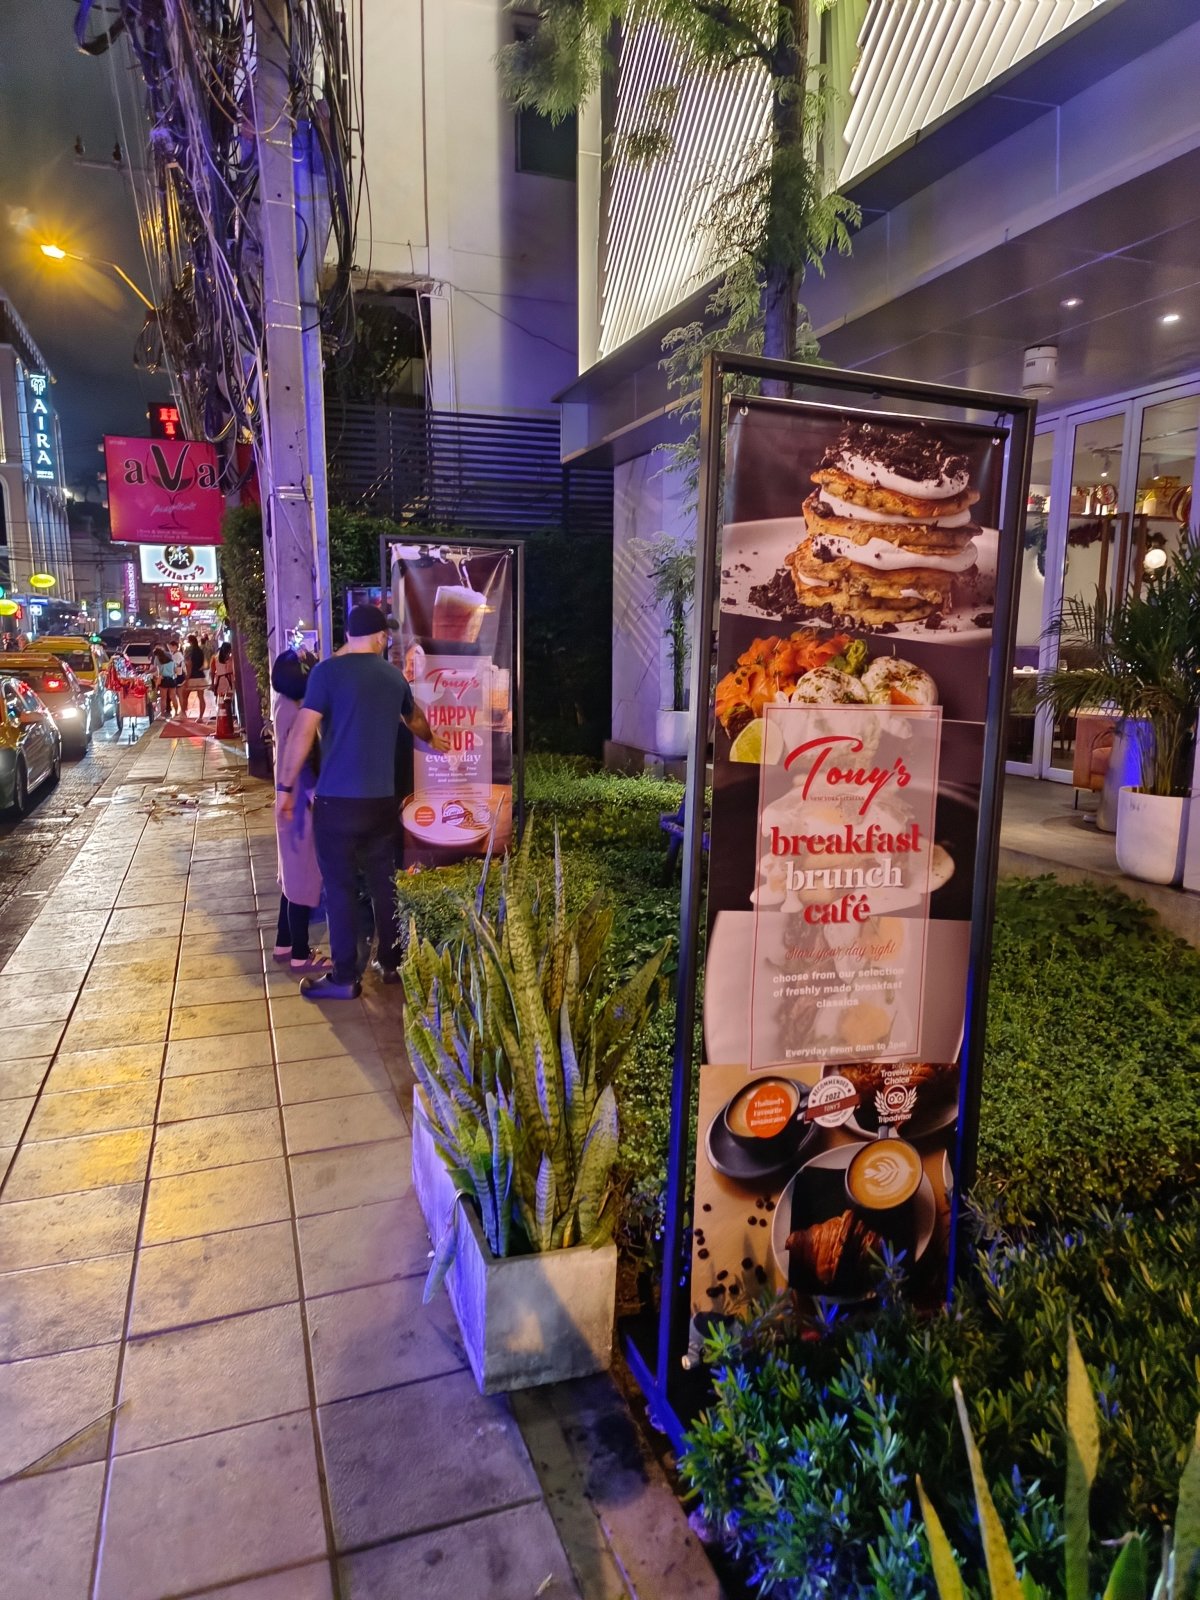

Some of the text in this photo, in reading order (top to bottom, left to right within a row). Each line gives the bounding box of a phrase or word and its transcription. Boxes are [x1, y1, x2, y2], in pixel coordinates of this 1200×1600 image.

[33, 398, 52, 465] AIRA
[127, 562, 136, 609] Ambassador
[425, 668, 480, 699] Tony's
[427, 705, 477, 726] HAPPY
[442, 730, 475, 751] OUR
[425, 751, 481, 764] everyday
[784, 736, 911, 815] Tony's
[771, 824, 922, 857] breakfast
[786, 858, 904, 891] brunch
[803, 893, 871, 925] café
[846, 941, 867, 961] day
[871, 940, 896, 962] right
[772, 967, 905, 984] choose from our selection
[772, 981, 902, 998] of freshly made breakfast
[816, 998, 859, 1008] classics
[785, 1047, 828, 1058] Everyday
[830, 1045, 853, 1055] From
[876, 1042, 886, 1051] to
[812, 1078, 849, 1097] RECOMMENDED
[884, 1076, 911, 1086] Choice
[825, 1091, 841, 1102] 2022
[878, 1113, 912, 1124] Tripadvisor
